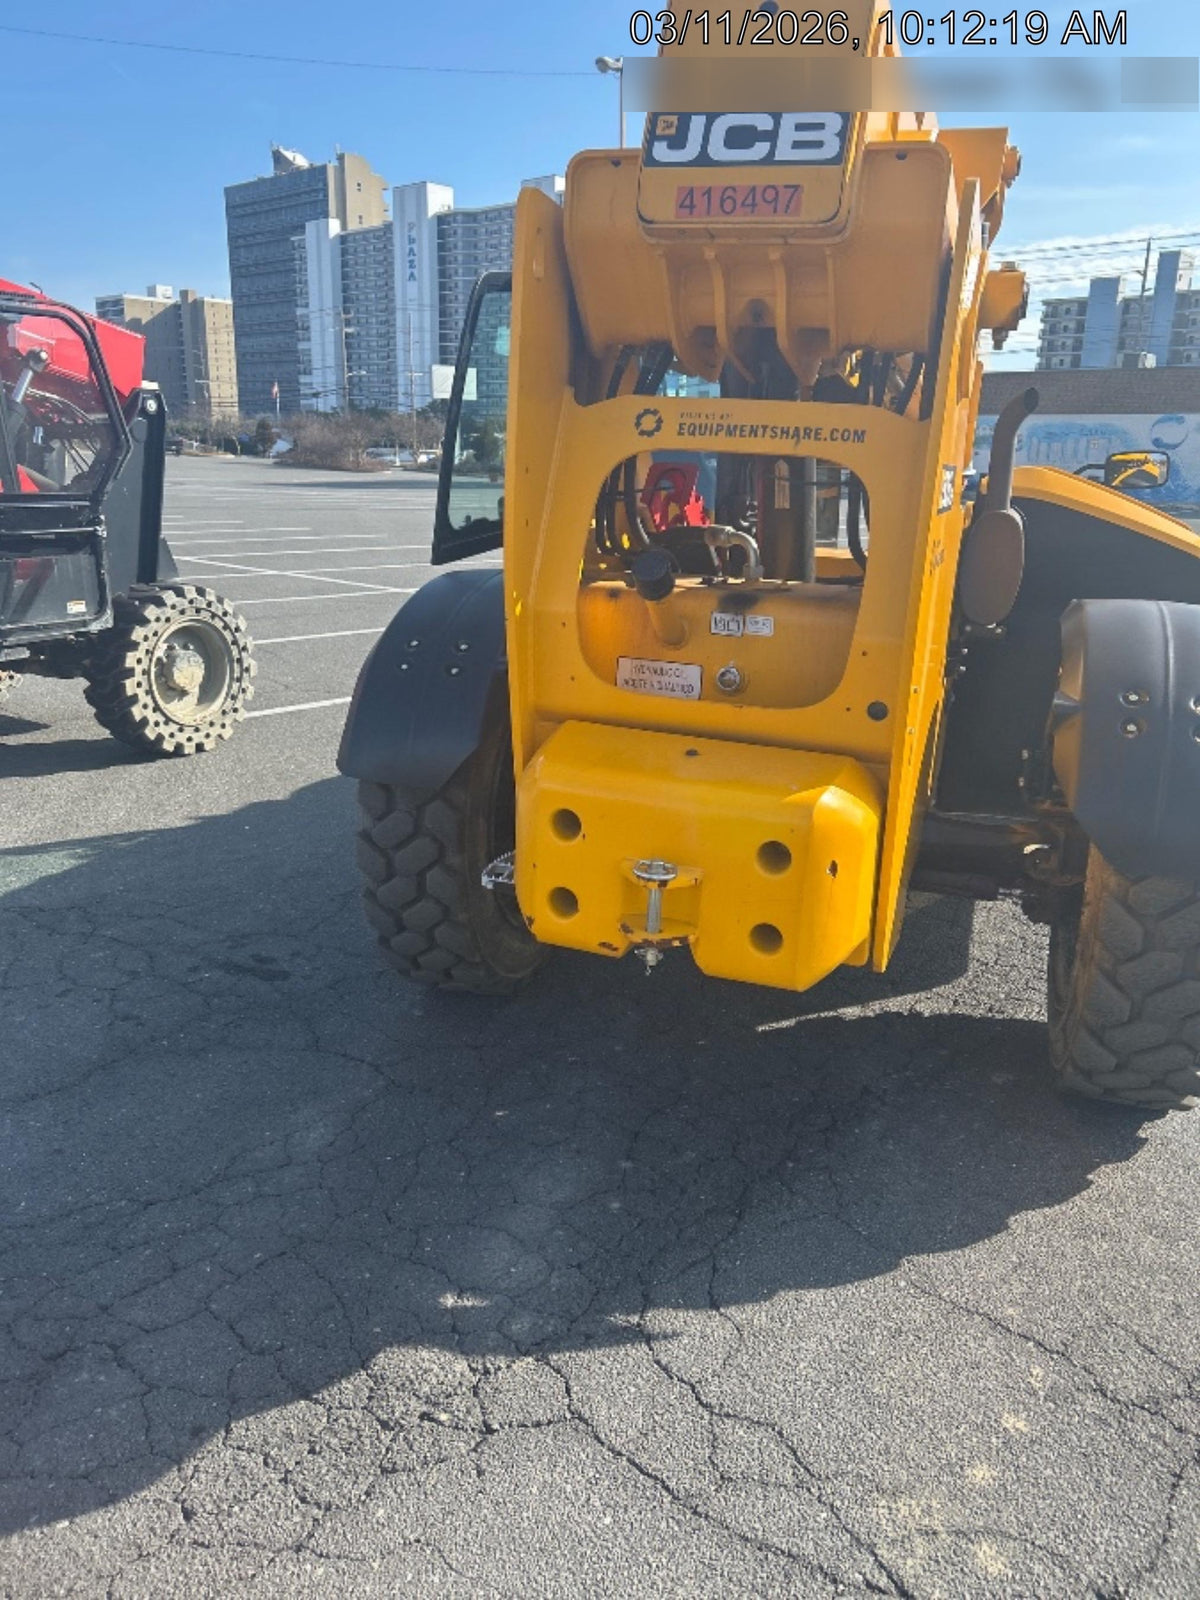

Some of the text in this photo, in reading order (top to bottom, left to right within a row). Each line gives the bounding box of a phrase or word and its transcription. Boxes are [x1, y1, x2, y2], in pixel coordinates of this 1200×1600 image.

[652, 112, 844, 163] JCB
[678, 184, 801, 216] 416497
[677, 422, 867, 444] EQUIPMENTSHARE.COM
